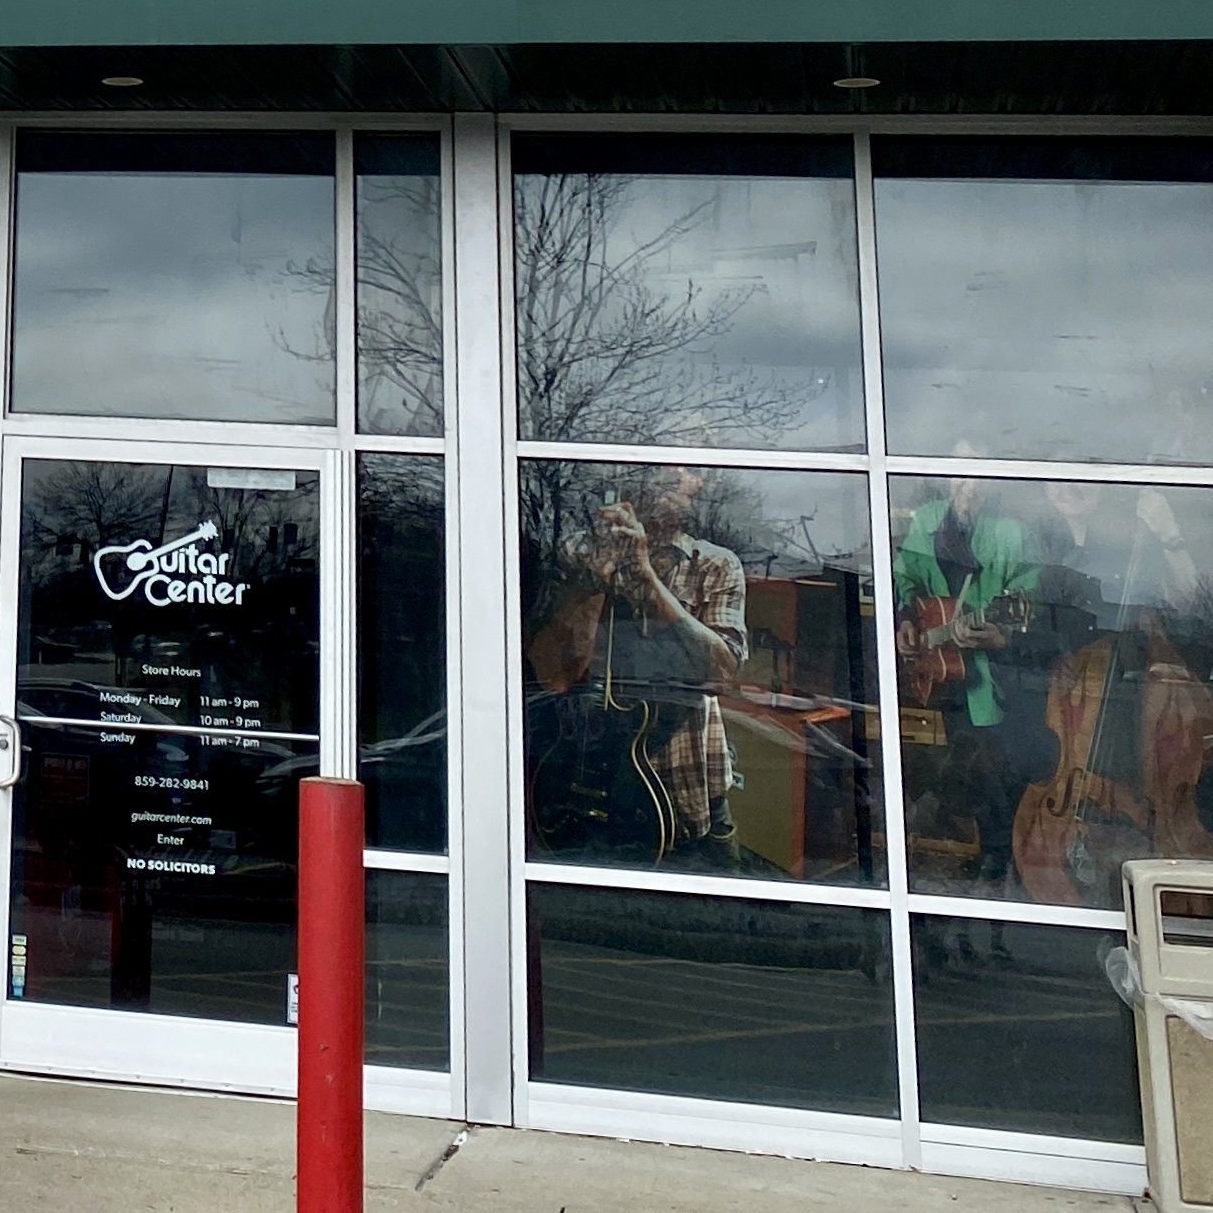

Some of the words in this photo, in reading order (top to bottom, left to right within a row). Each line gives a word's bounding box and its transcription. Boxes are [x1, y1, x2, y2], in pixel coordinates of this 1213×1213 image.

[145, 574, 247, 607] Center
[142, 664, 169, 676] Store
[171, 666, 202, 678] Hours
[99, 692, 142, 706] Monday
[149, 694, 181, 708] Friday
[200, 696, 209, 707] 11
[211, 699, 227, 708] am
[234, 697, 241, 708] 9
[243, 700, 259, 710] pm
[100, 711, 142, 724] Saturday
[200, 715, 211, 726] 10
[212, 718, 228, 727] am
[235, 716, 243, 728] 9
[244, 719, 261, 729] pm
[100, 731, 136, 744] Sunday
[200, 735, 209, 746] 11
[211, 738, 227, 747] am
[235, 737, 241, 747] 7
[243, 739, 260, 749] pm
[134, 776, 209, 790] 859-282-9841
[131, 810, 212, 825] guitarcenter.com
[157, 833, 185, 846] Enter
[127, 857, 146, 870] NO
[147, 859, 216, 875] SOLICITORS
